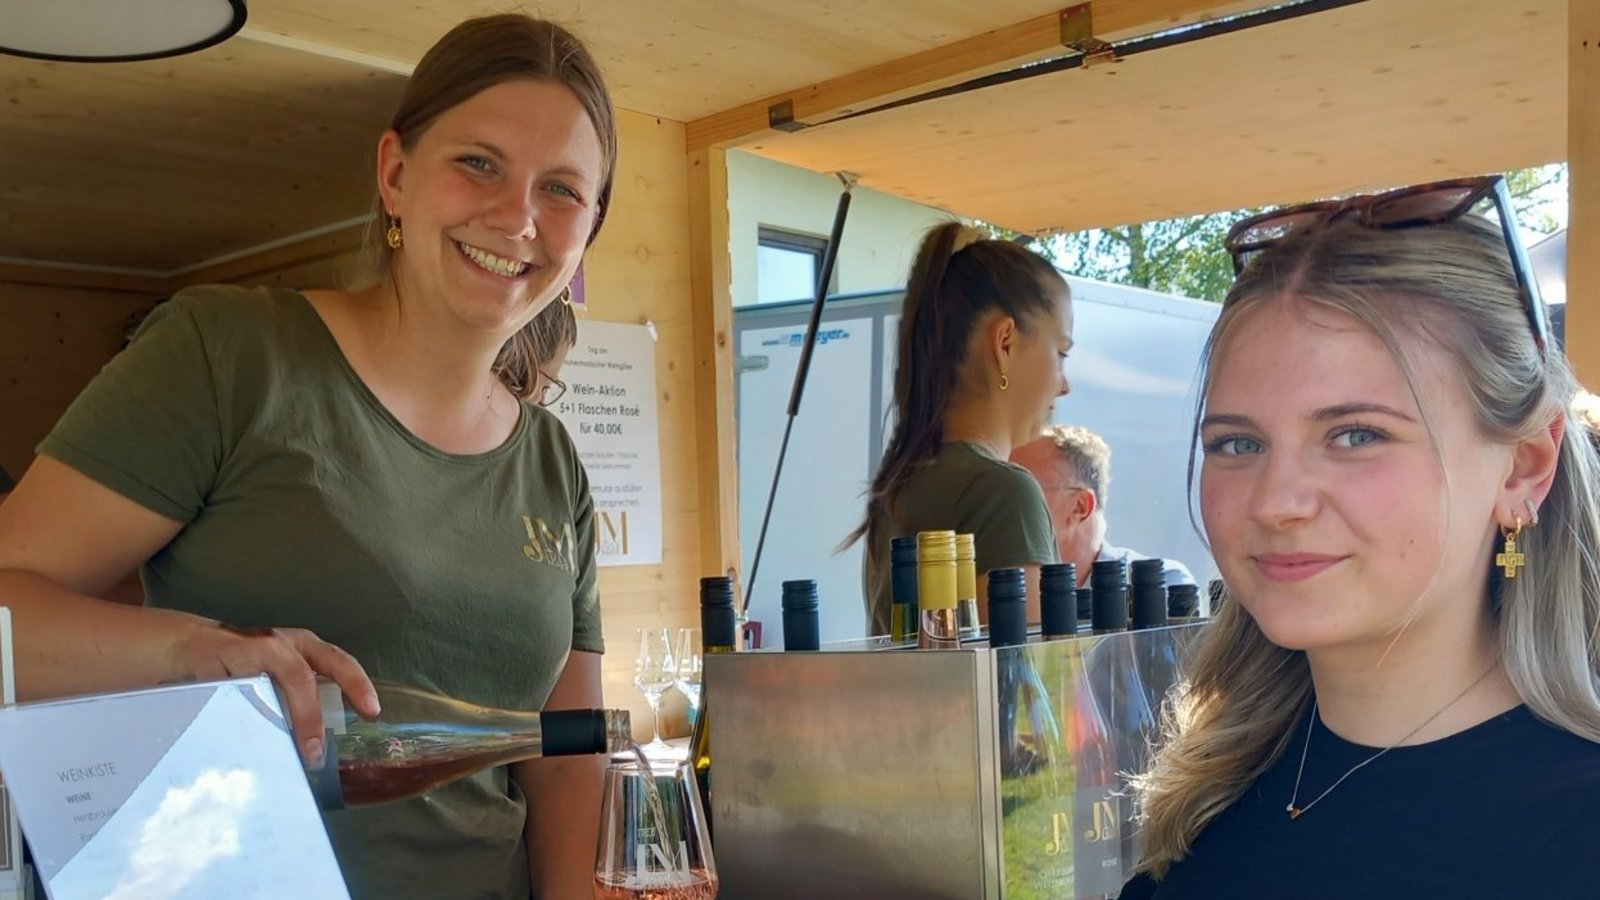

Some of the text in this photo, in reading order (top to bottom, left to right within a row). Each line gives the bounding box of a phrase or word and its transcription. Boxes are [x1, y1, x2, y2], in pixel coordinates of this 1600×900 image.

[588, 346, 598, 355] Tag
[572, 383, 626, 397] Wein-Aktion
[560, 402, 640, 417] 5+1 Flaschen Rosé
[580, 422, 592, 434] für
[57, 762, 118, 783] WEINKISTE
[66, 791, 92, 805] WEINE
